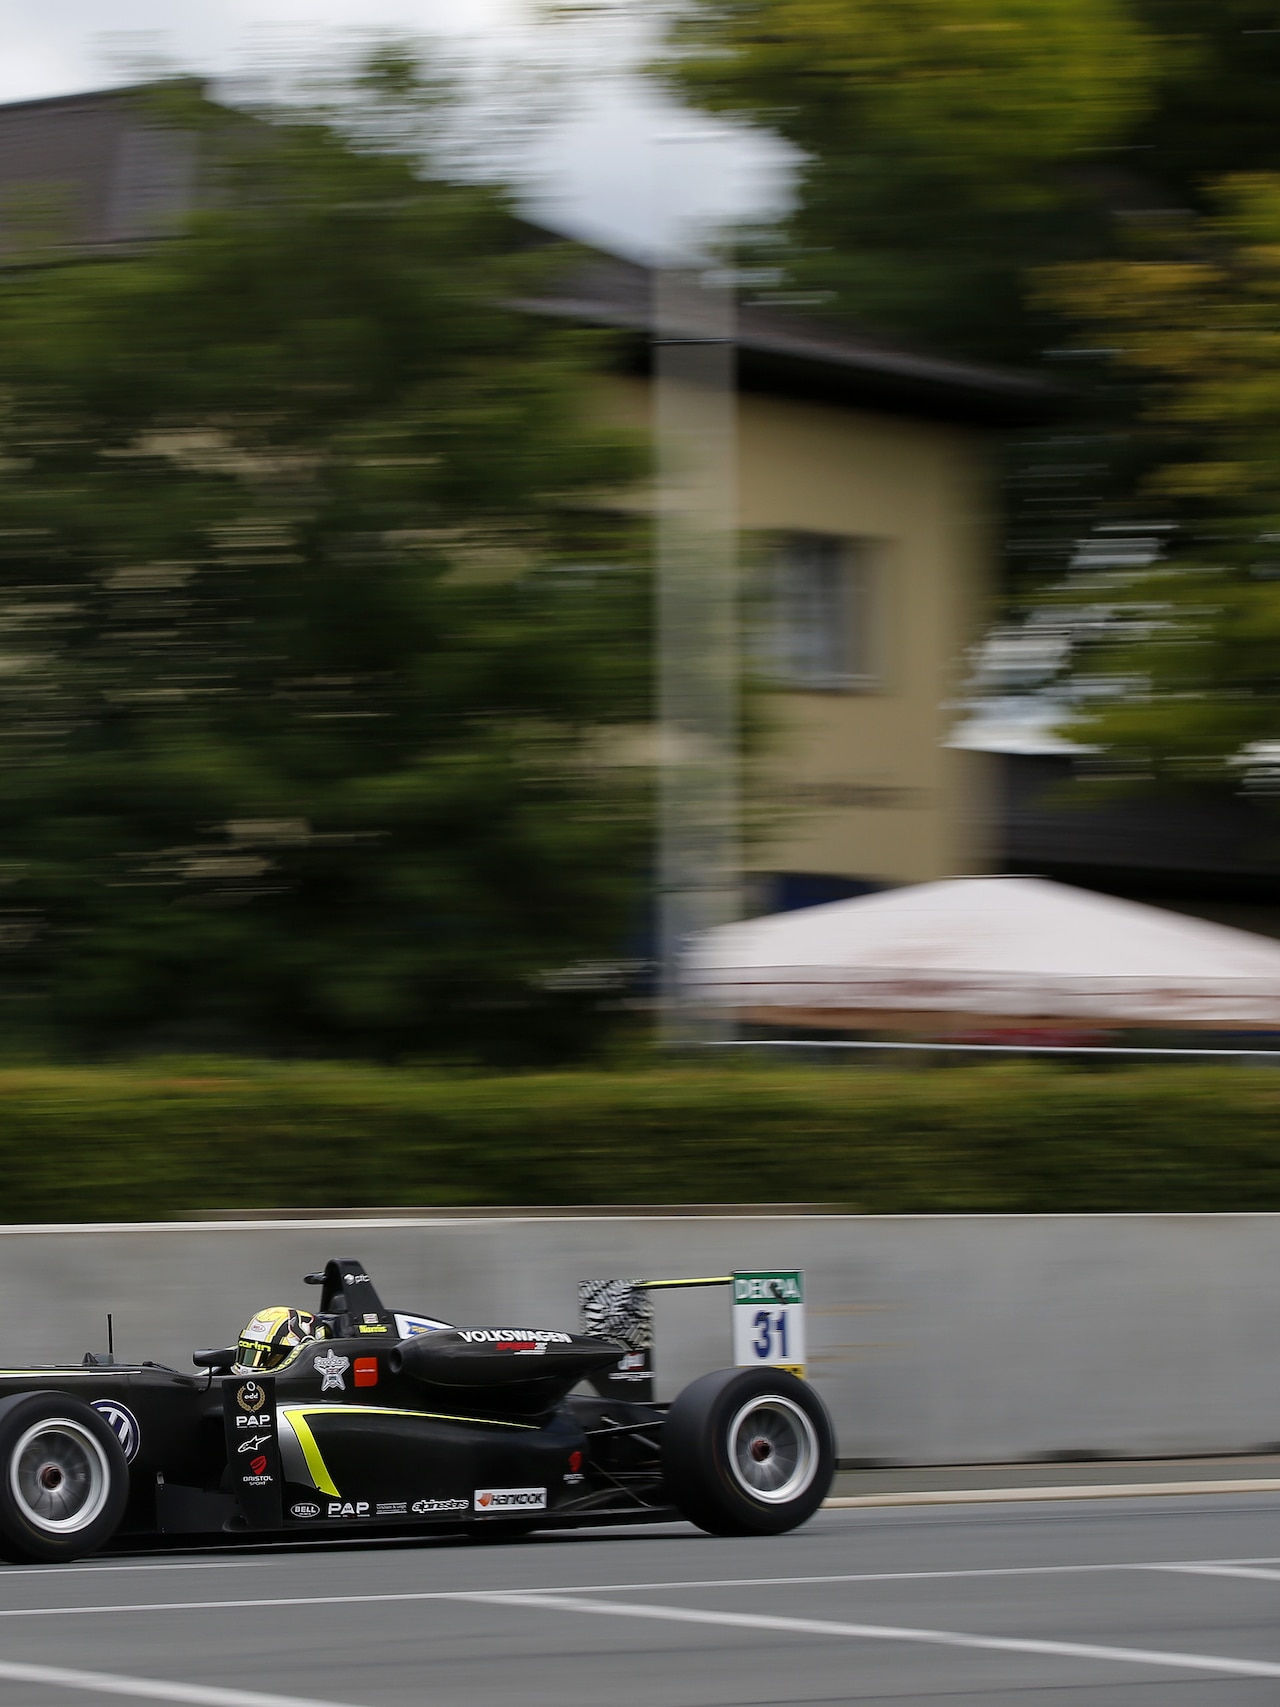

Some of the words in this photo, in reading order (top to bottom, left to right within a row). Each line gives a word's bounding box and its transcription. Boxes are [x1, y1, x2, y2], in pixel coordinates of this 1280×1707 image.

[458, 1329, 573, 1343] VOLKSWAGEN
[752, 1310, 788, 1358] 31
[238, 1340, 271, 1353] carlin
[236, 1415, 271, 1426] PAP
[328, 1502, 369, 1514] PAP
